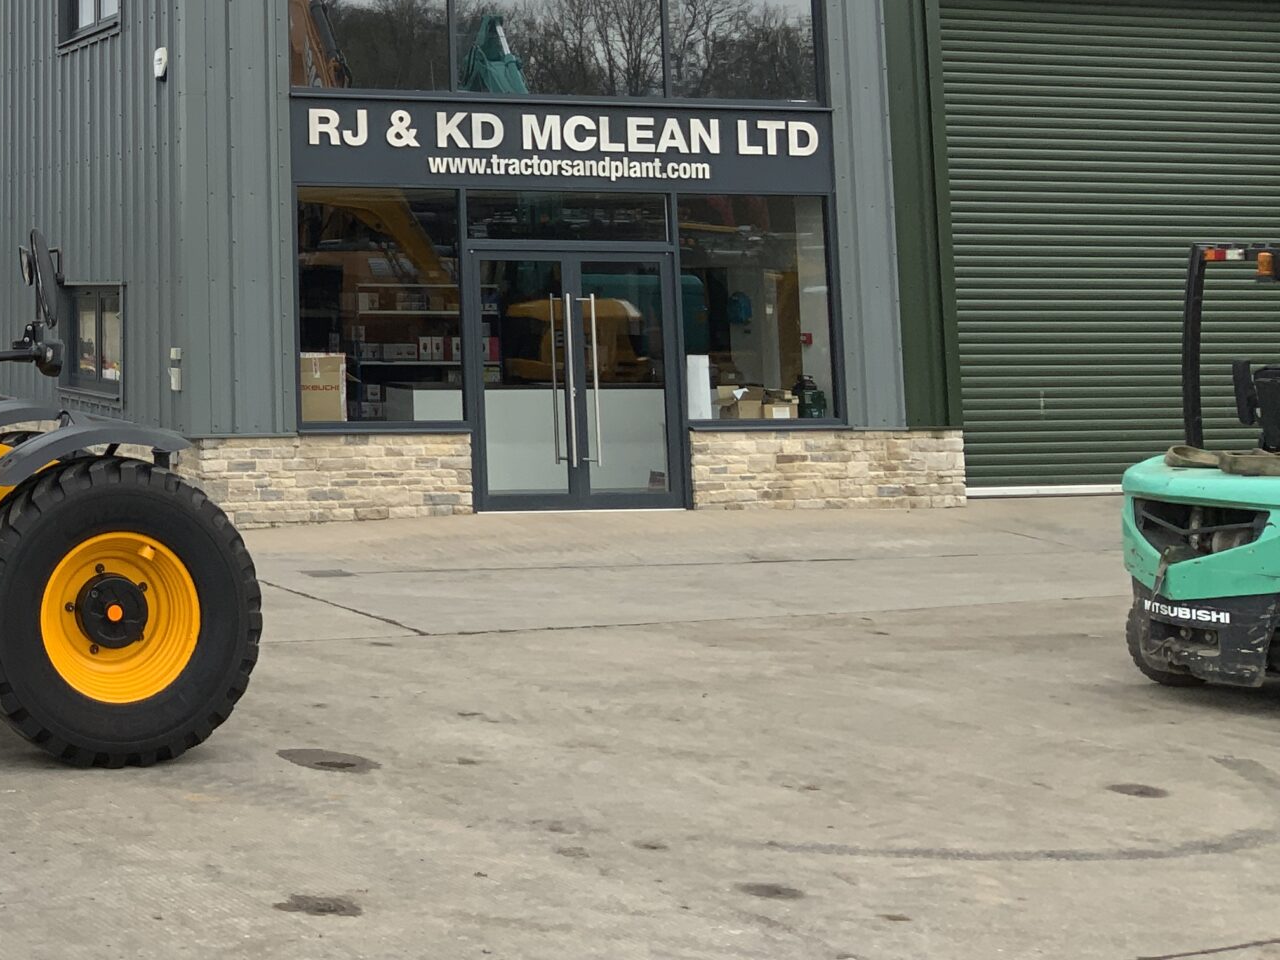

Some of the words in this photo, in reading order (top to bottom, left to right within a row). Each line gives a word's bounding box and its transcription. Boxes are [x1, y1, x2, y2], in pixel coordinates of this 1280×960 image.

[308, 108, 369, 147] RJ
[386, 109, 421, 148] &
[436, 111, 505, 149] KD
[521, 113, 721, 155] MCLEAN
[736, 119, 820, 157] LTD
[427, 154, 712, 181] www.tractorsandplant.com
[1144, 599, 1231, 624] MITSUBISHI
